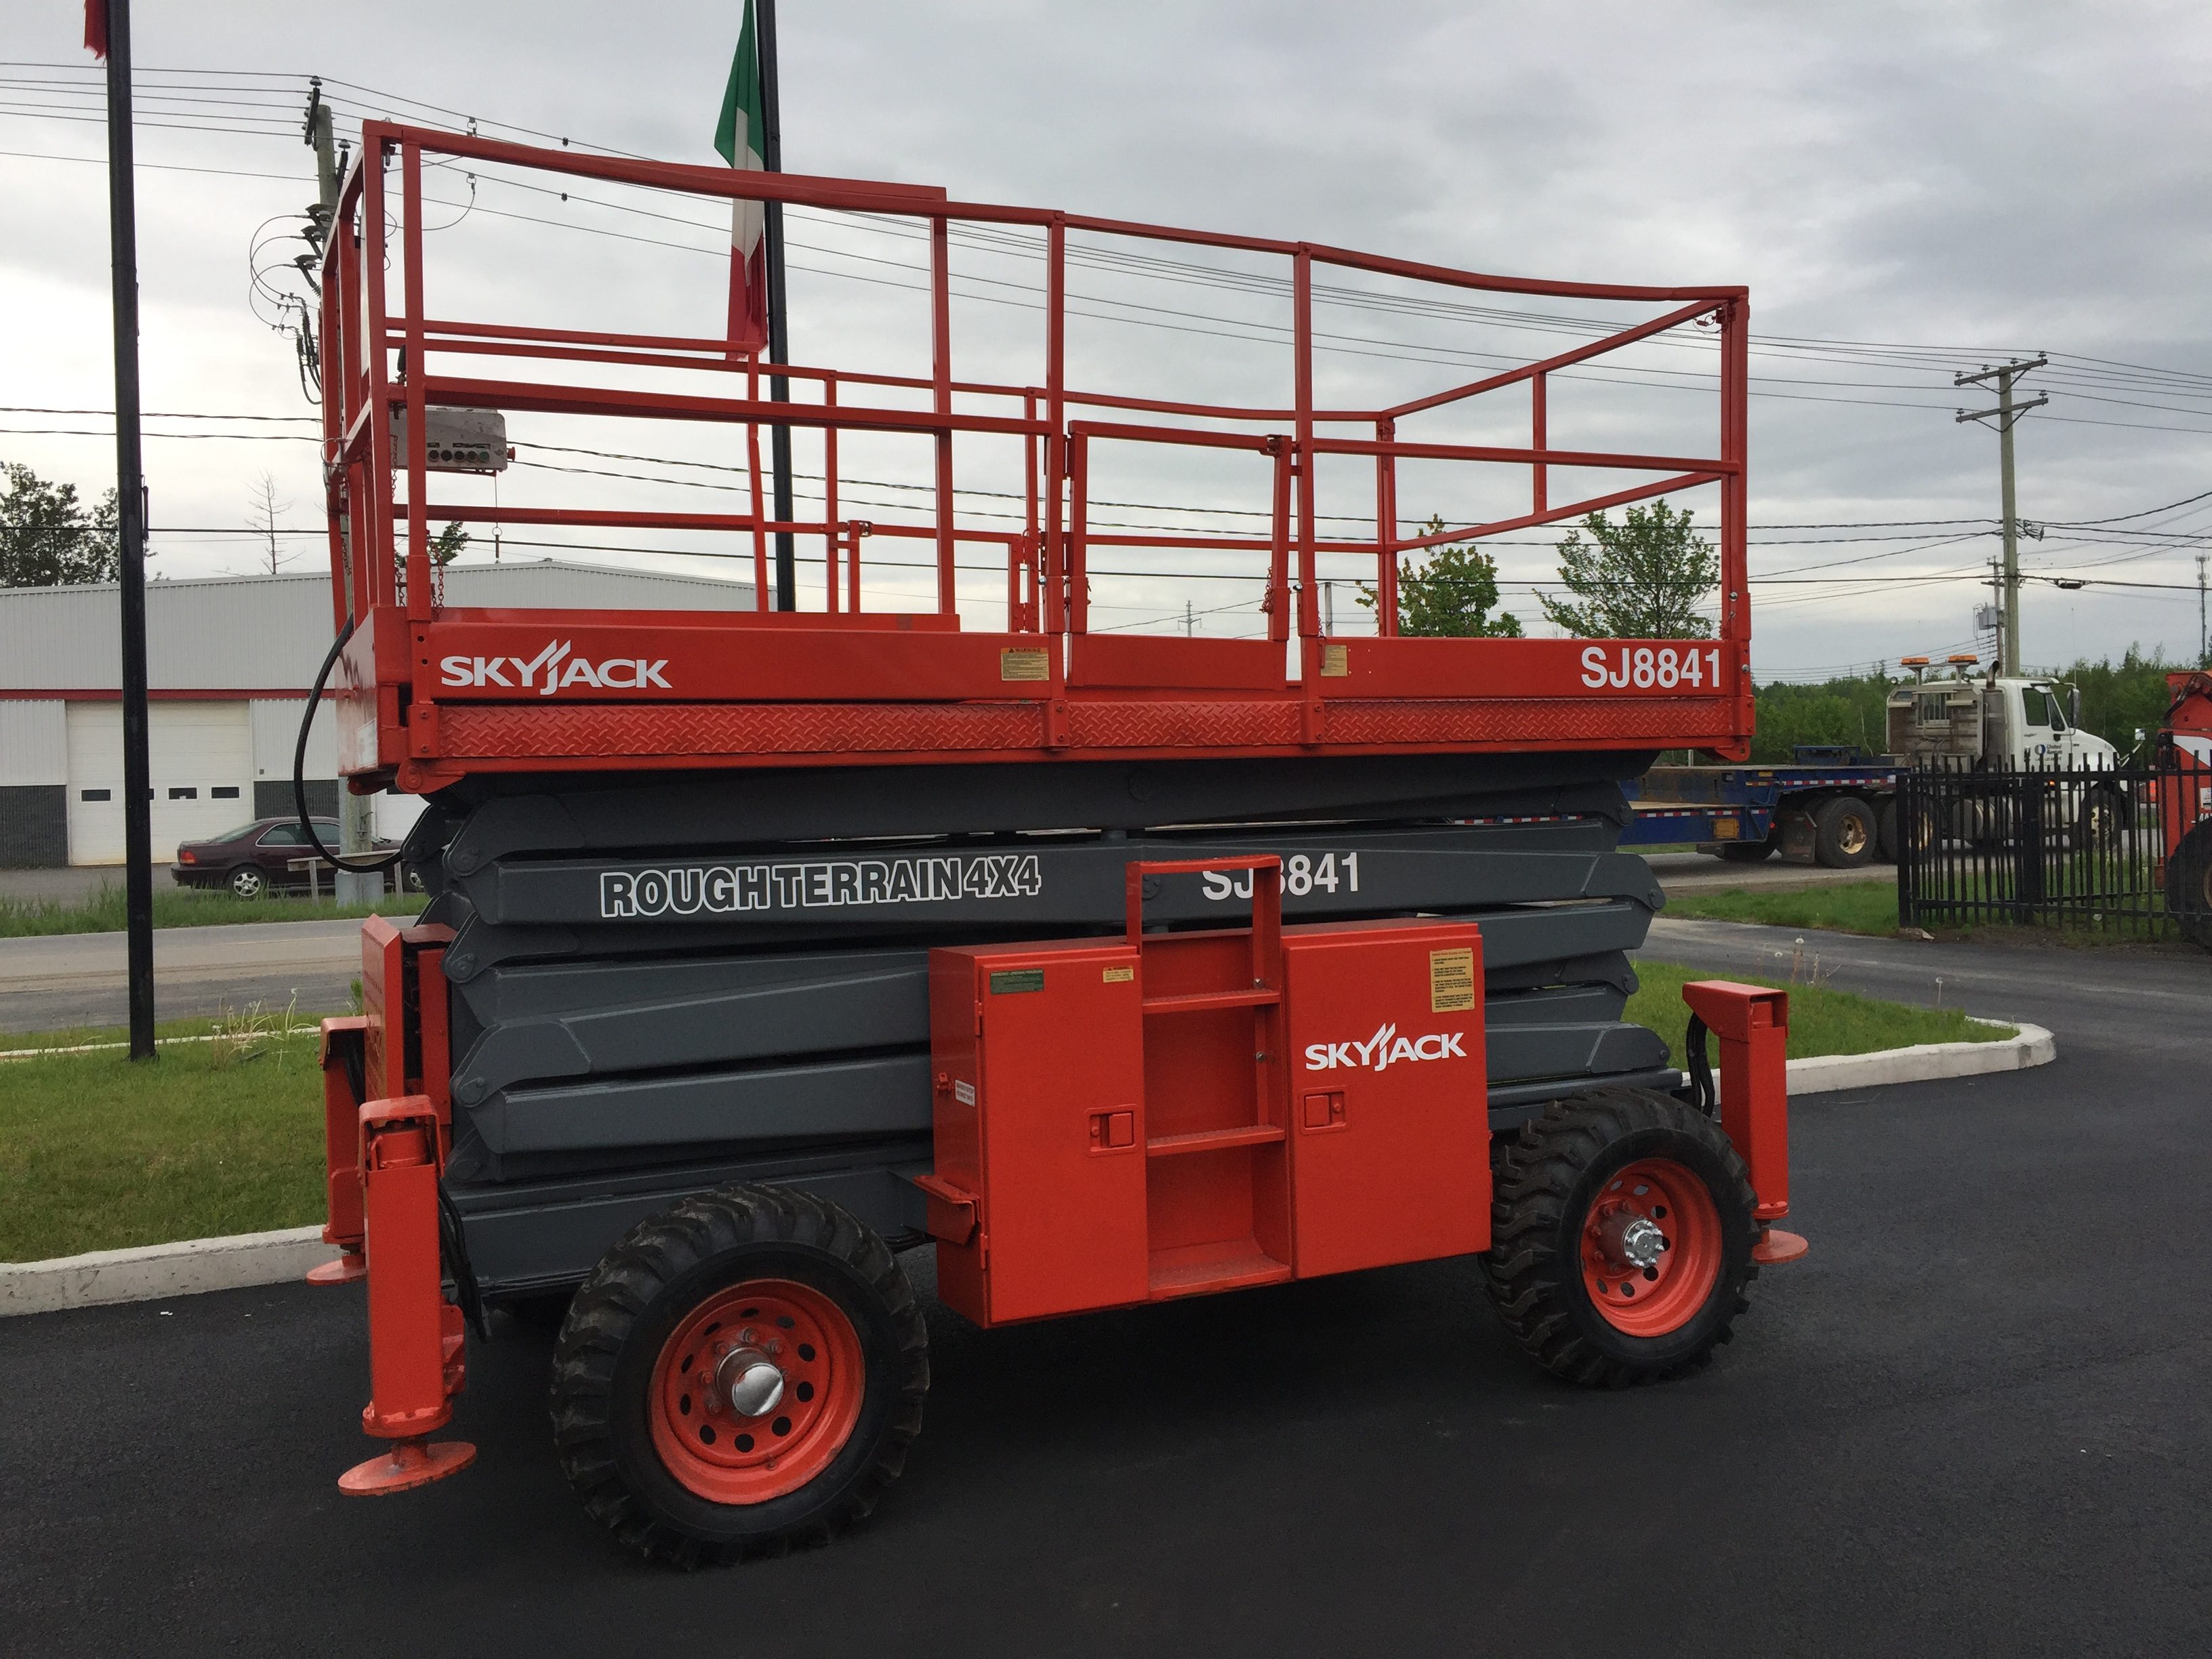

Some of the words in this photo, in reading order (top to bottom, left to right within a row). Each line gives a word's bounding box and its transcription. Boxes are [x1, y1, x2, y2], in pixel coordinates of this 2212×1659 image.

[439, 638, 673, 695] SKYJACK
[1581, 647, 1720, 689] SJ8841
[964, 855, 1042, 898] 4X4
[1202, 852, 1358, 901] SJ841
[1305, 1023, 1467, 1071] SKYJACK
